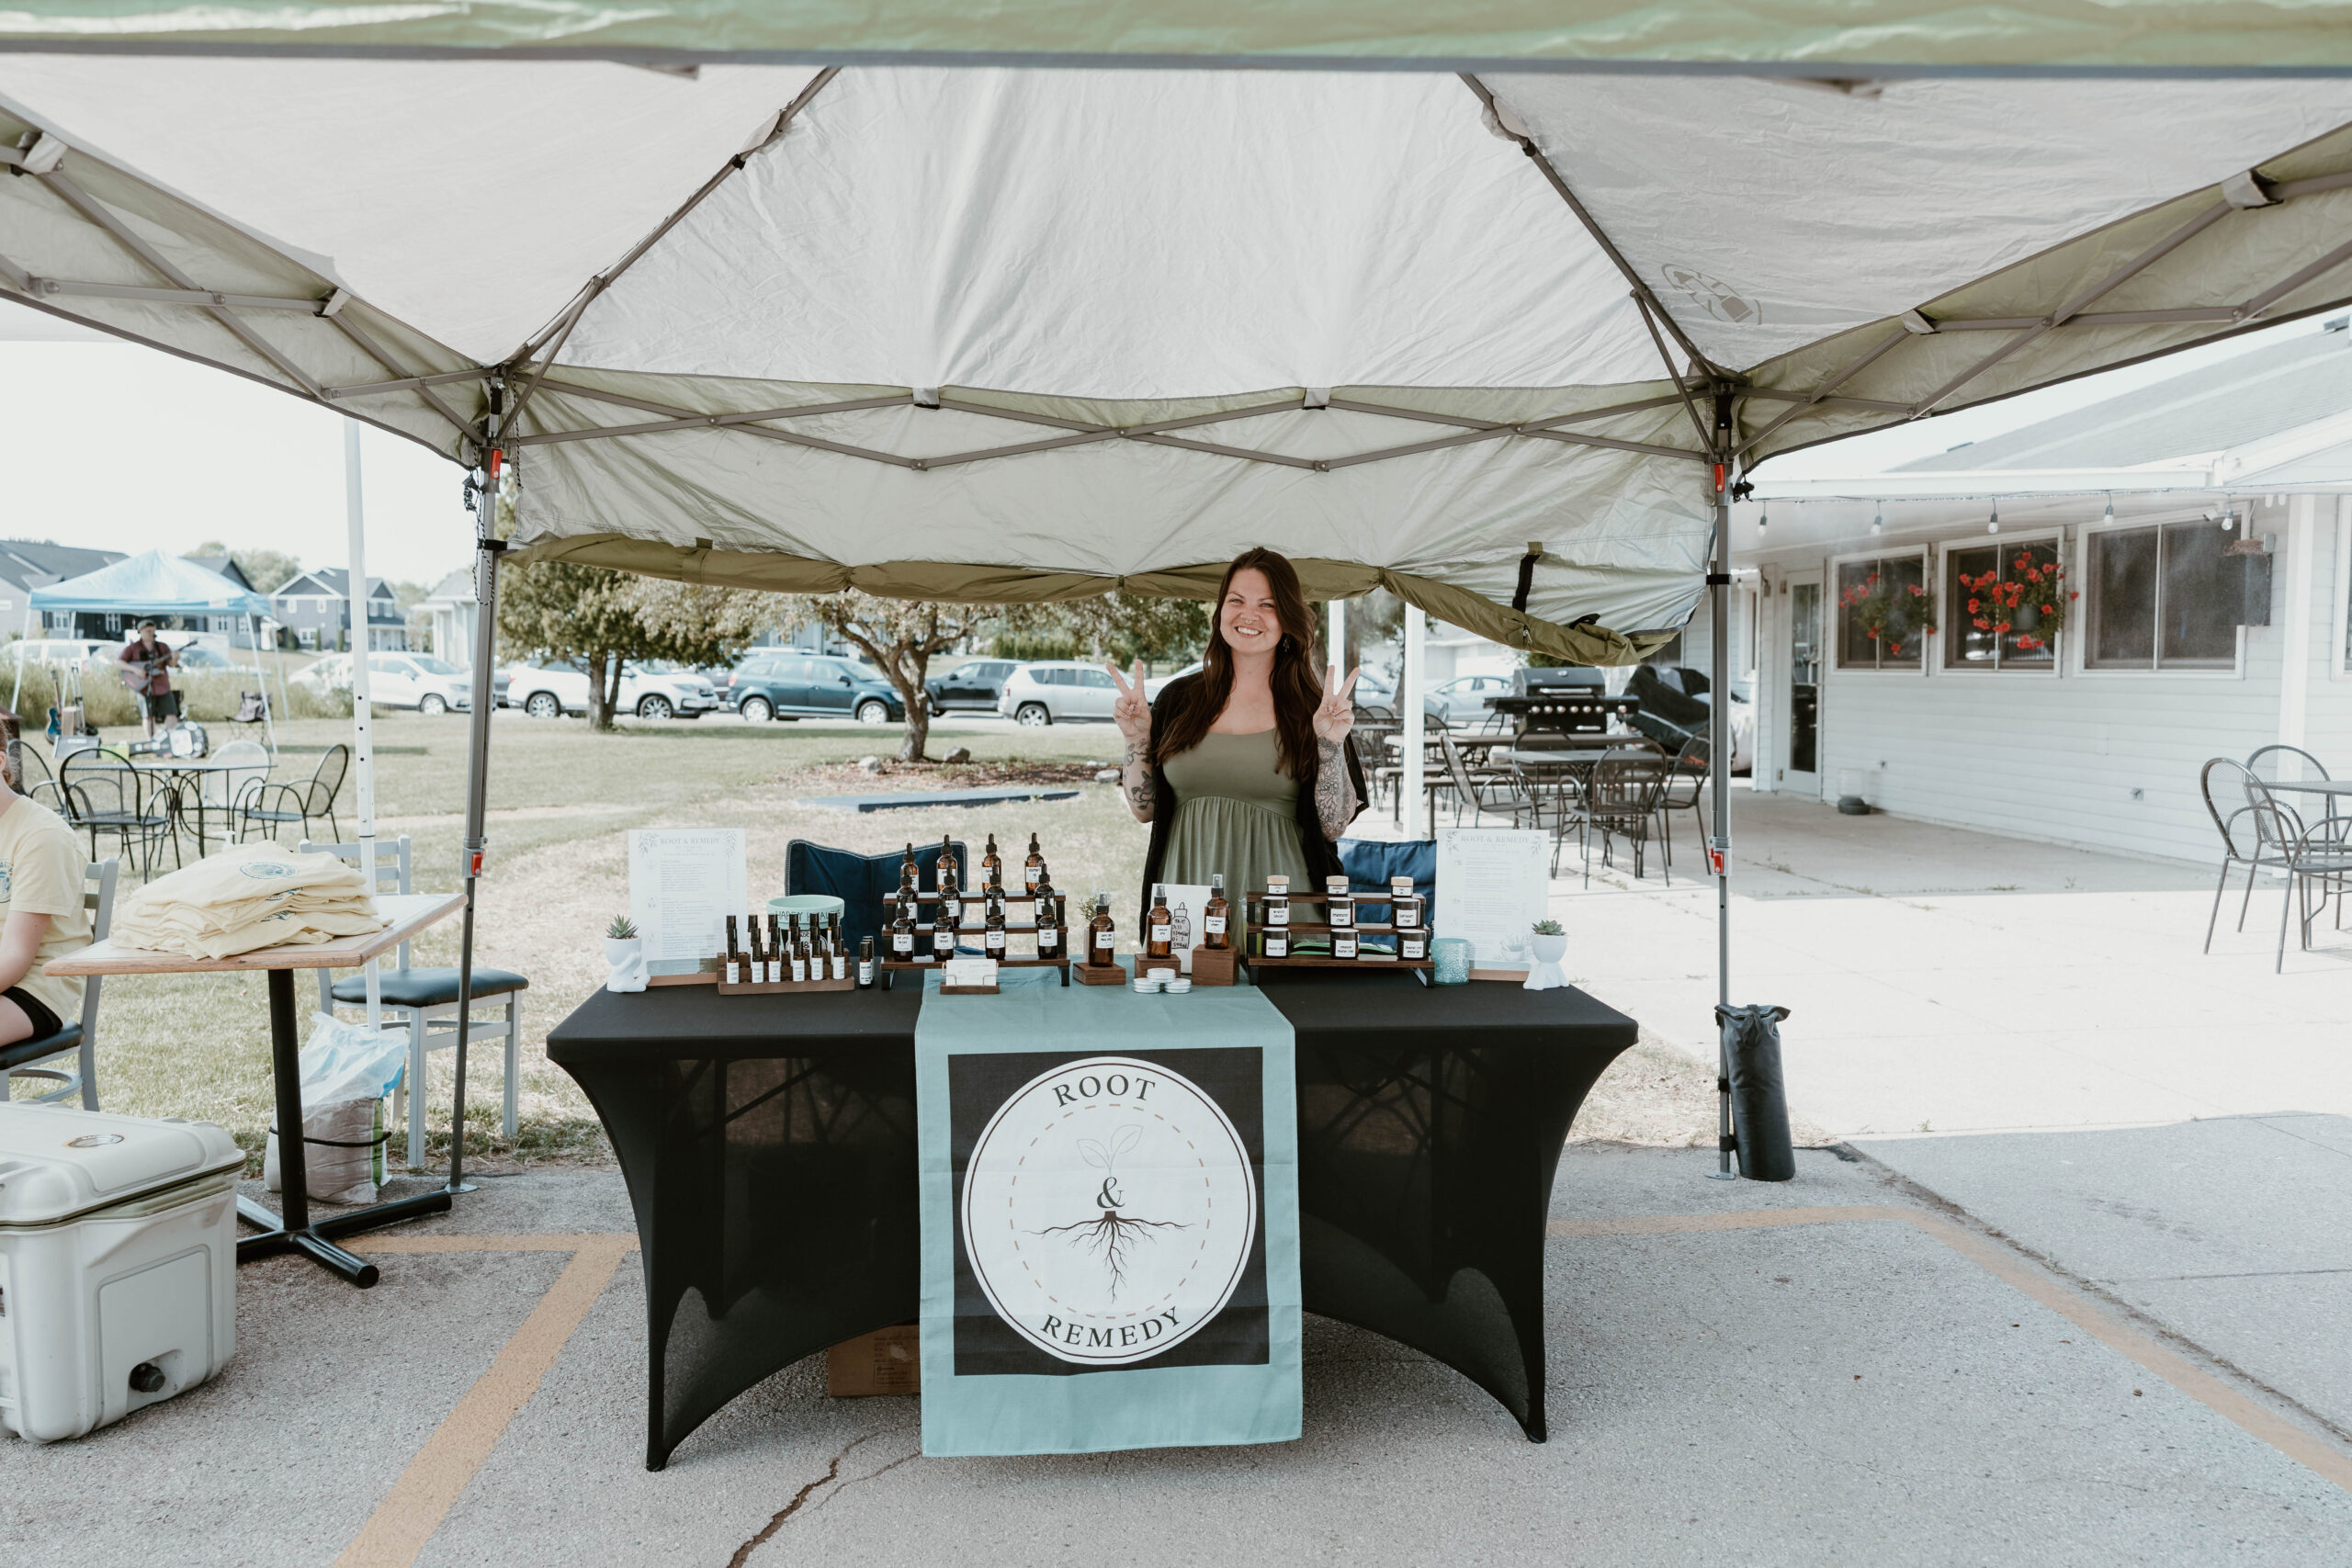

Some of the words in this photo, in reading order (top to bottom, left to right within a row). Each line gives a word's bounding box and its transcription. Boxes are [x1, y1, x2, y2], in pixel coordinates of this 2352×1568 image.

[660, 837, 682, 845] ROOT
[683, 837, 689, 845] &
[690, 837, 720, 845] REMEDY
[1461, 835, 1484, 843] ROOT
[1496, 836, 1530, 844] REMEDY
[775, 910, 802, 921] HAPY
[1051, 1074, 1156, 1108] ROOT
[1096, 1176, 1125, 1209] &
[1040, 1305, 1181, 1348] REMEDY
